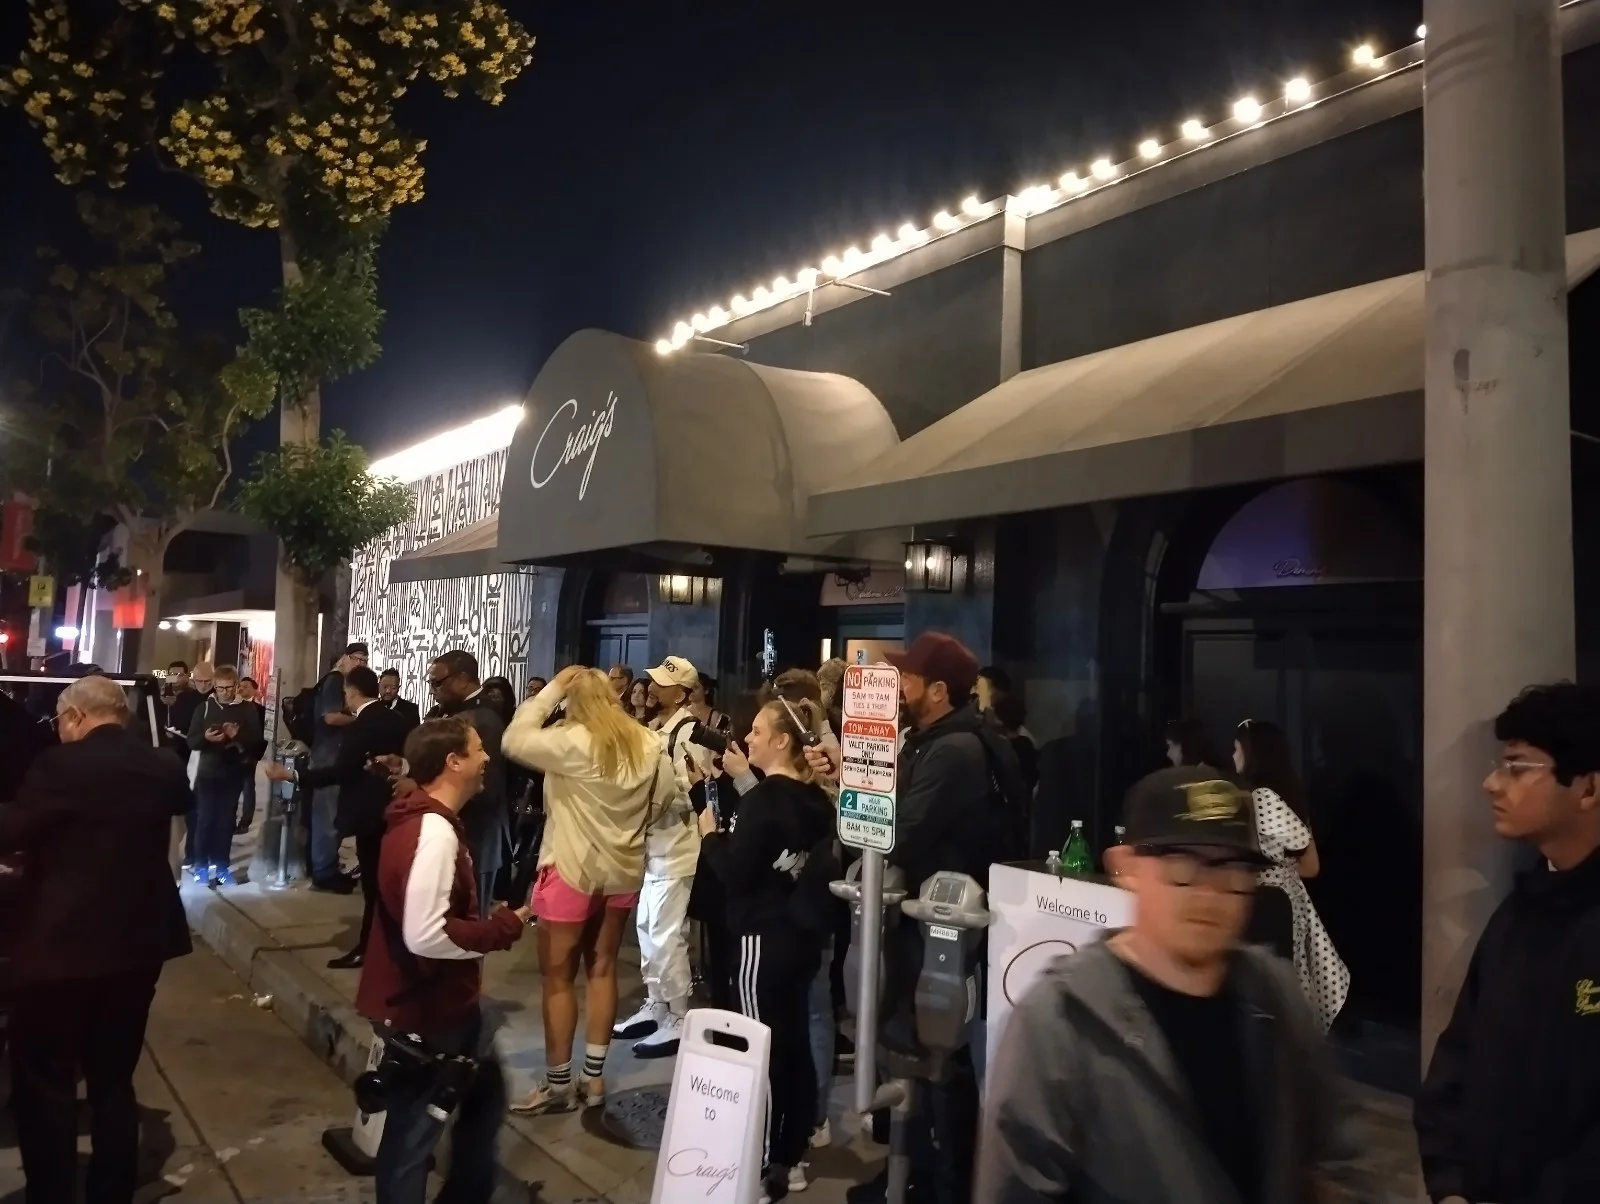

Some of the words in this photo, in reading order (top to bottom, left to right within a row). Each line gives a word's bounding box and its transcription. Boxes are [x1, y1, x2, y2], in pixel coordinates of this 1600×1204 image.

[530, 390, 618, 501] Craig's
[847, 672, 861, 686] NO
[863, 676, 896, 689] PARKING
[852, 692, 866, 700] 5AM
[876, 693, 890, 701] 7AM
[848, 722, 890, 736] TOW-AWAY
[849, 740, 865, 750] VALET
[866, 742, 890, 753] PARKING
[861, 750, 875, 759] ONLY
[846, 793, 853, 808] 2
[862, 803, 888, 817] PARKING
[846, 822, 861, 832] 8AM
[872, 827, 886, 837] 5PM
[1036, 894, 1090, 920] Welcome
[1094, 910, 1107, 924] to
[690, 1074, 740, 1104] Welcome
[704, 1106, 716, 1121] to
[667, 1147, 739, 1196] Craig's
